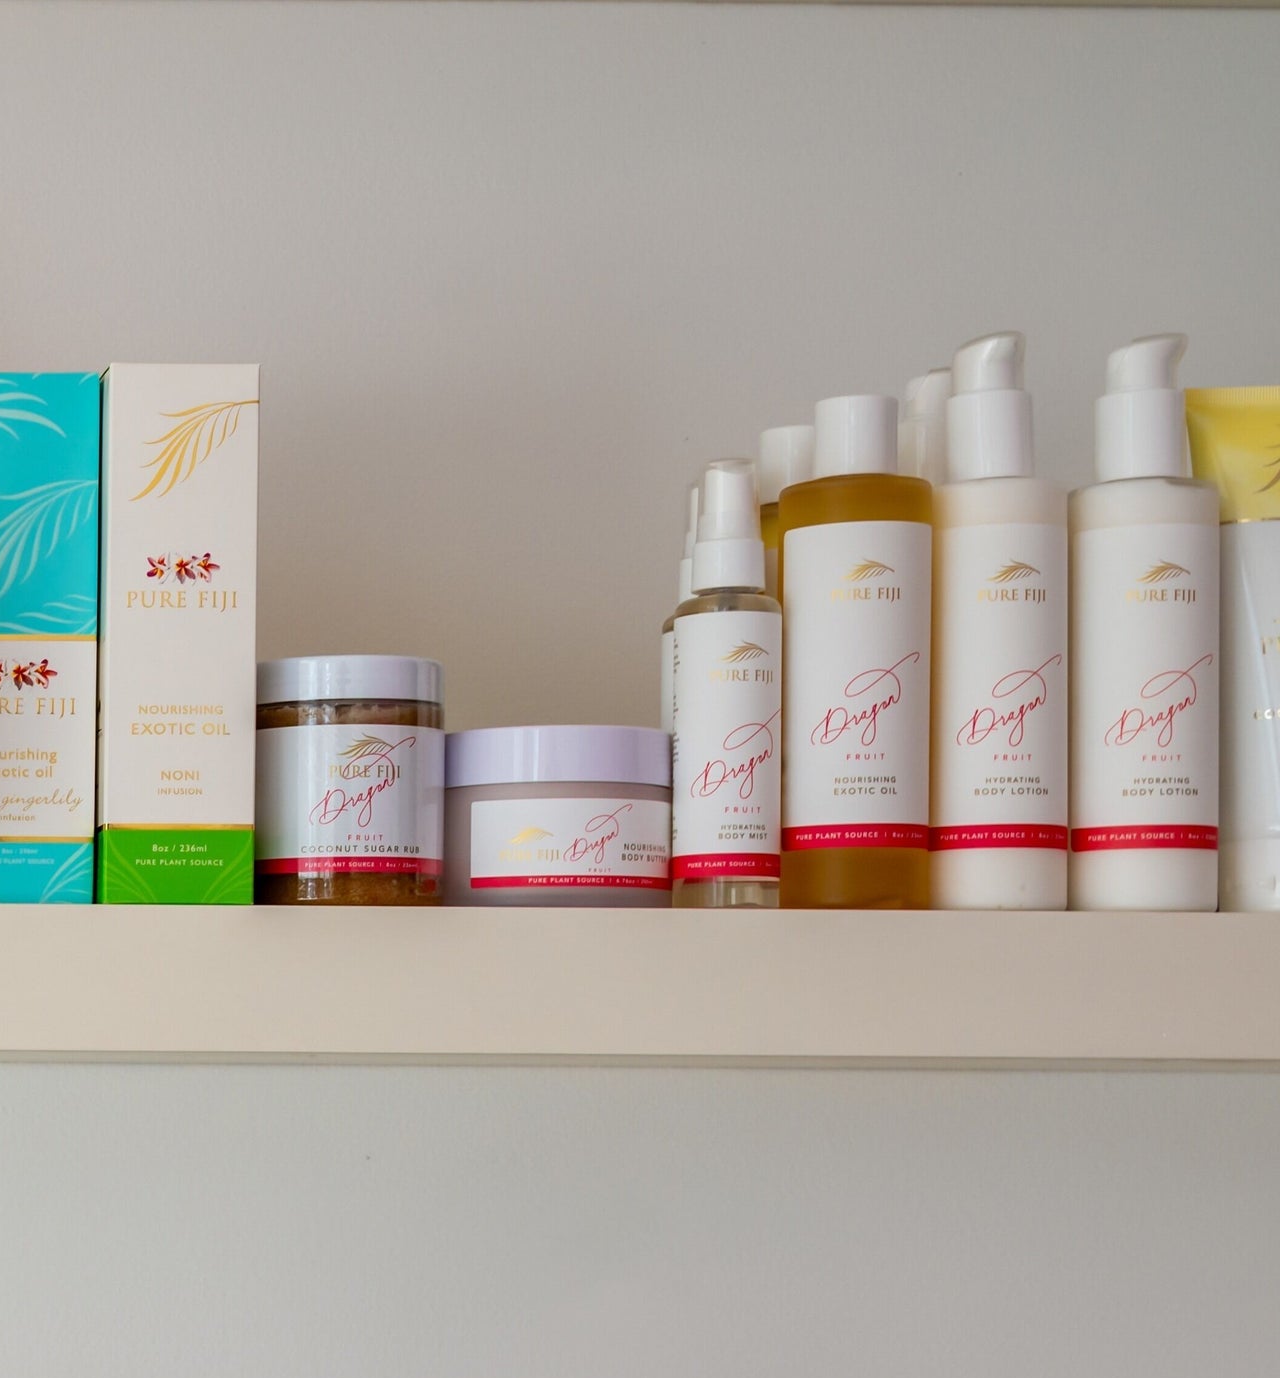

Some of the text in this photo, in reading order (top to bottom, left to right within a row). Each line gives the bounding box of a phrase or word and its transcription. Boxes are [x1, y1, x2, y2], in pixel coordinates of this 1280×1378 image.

[127, 591, 237, 612] PURE FIJI
[37, 698, 75, 718] FIJI
[138, 704, 224, 717] NOURISHING
[131, 723, 230, 735] EXOTIC OIL
[35, 764, 52, 778] oil
[161, 770, 199, 780] NONI
[835, 776, 896, 784] NOURISHING
[834, 786, 897, 795] EXOTIC OIL
[719, 831, 767, 839] BODY MIST
[300, 844, 421, 855] COCONUT SUGAR RUB
